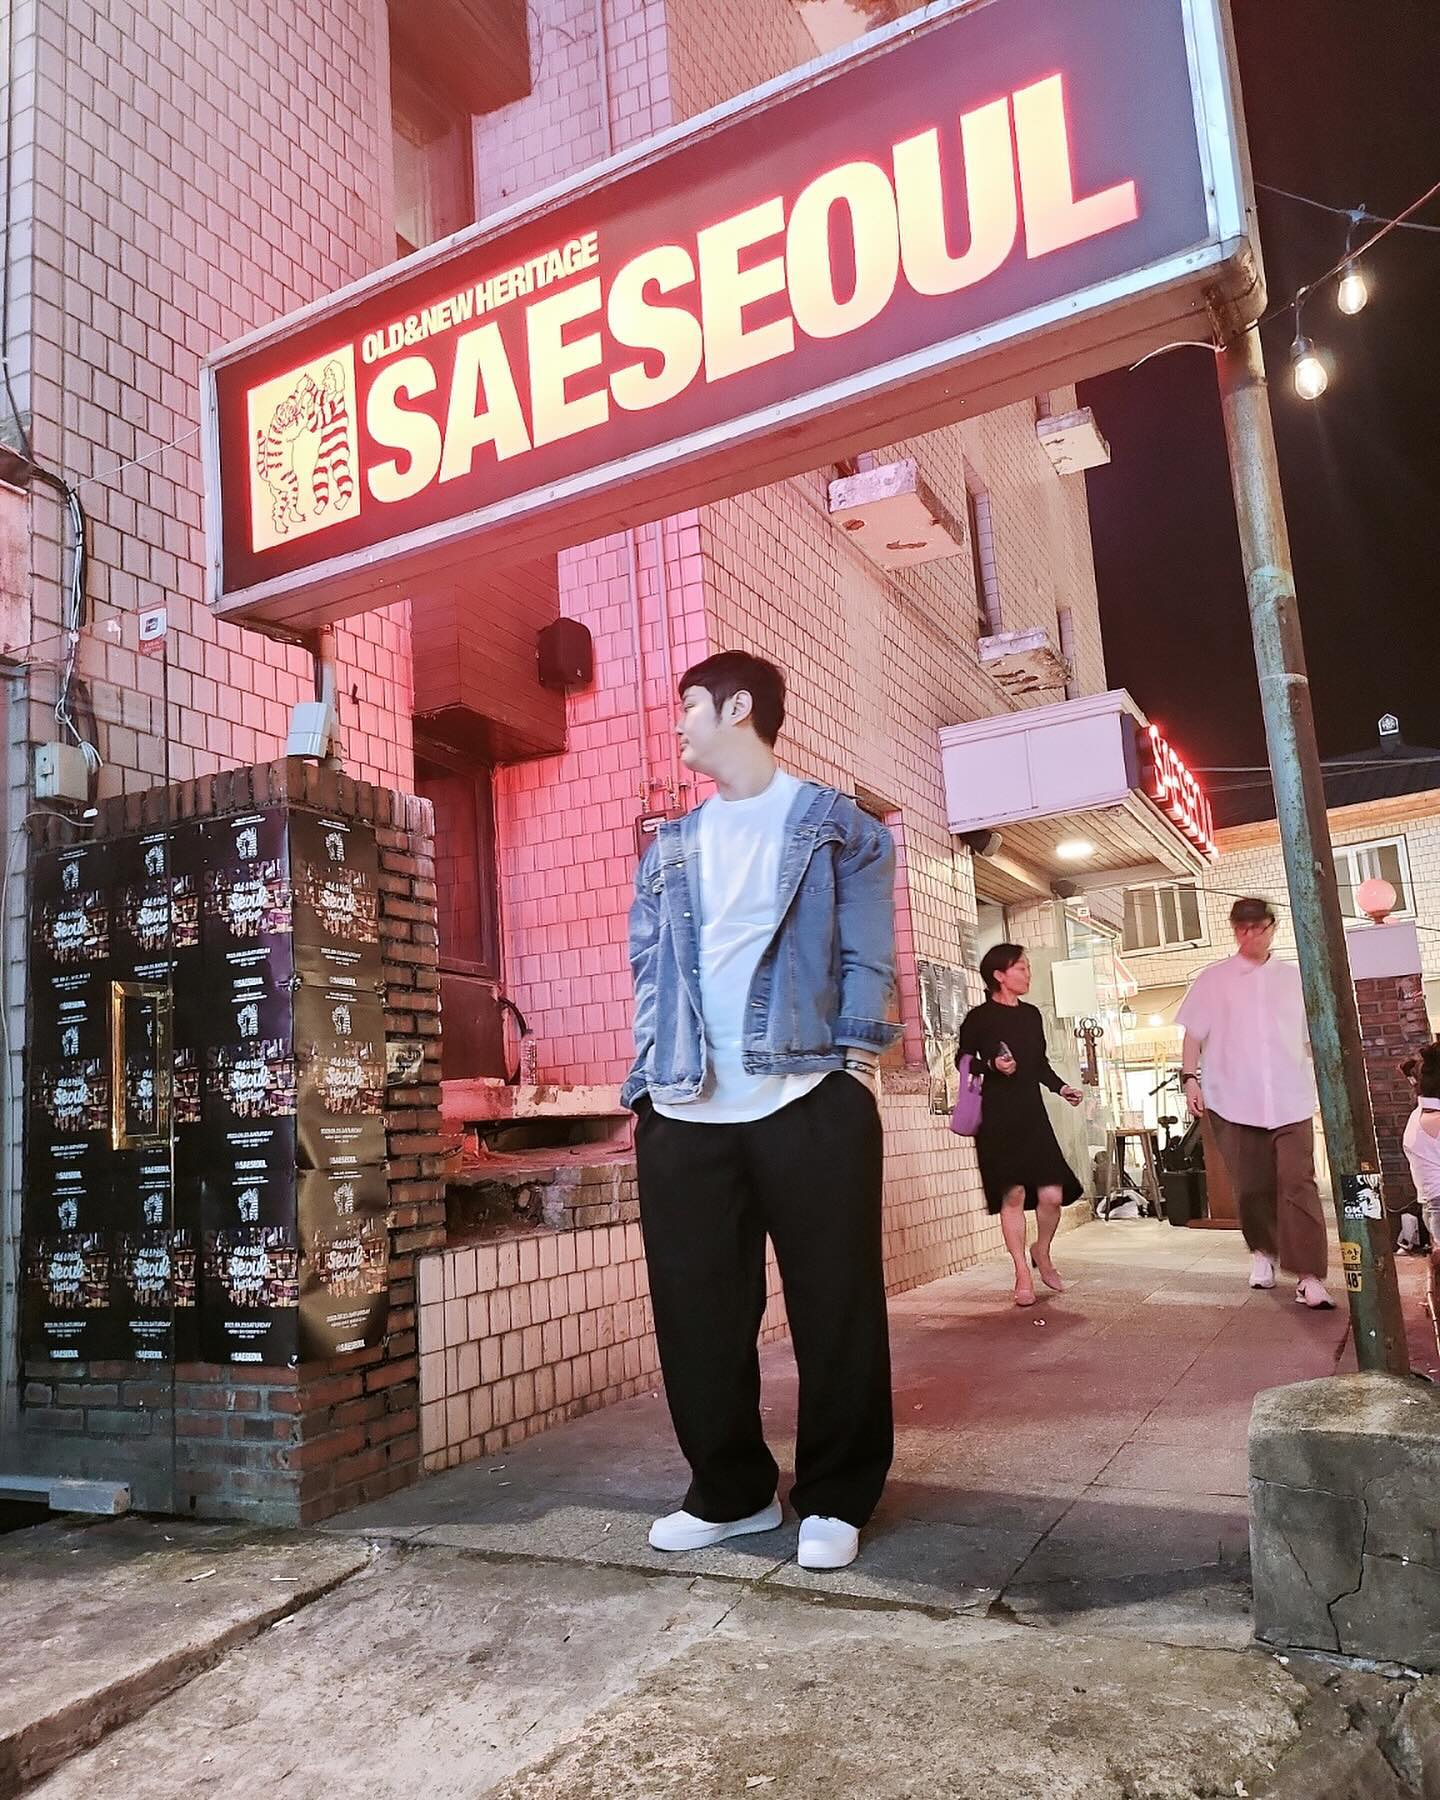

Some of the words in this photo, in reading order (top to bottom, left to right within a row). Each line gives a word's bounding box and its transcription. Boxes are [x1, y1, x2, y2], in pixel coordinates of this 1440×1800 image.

[366, 73, 1138, 504] SAESEOUL
[230, 887, 267, 910] Seoul
[321, 890, 355, 912] Seoul
[138, 908, 168, 923] Seou
[54, 917, 87, 937] Seoul
[231, 1067, 267, 1089] Seoul
[327, 1066, 364, 1085] Seoul
[54, 1084, 88, 1105] Seoul
[134, 1255, 170, 1277] Seoul
[230, 1253, 267, 1277] Seoul
[328, 1245, 364, 1269] Seoul
[49, 1259, 84, 1279] Seoul
